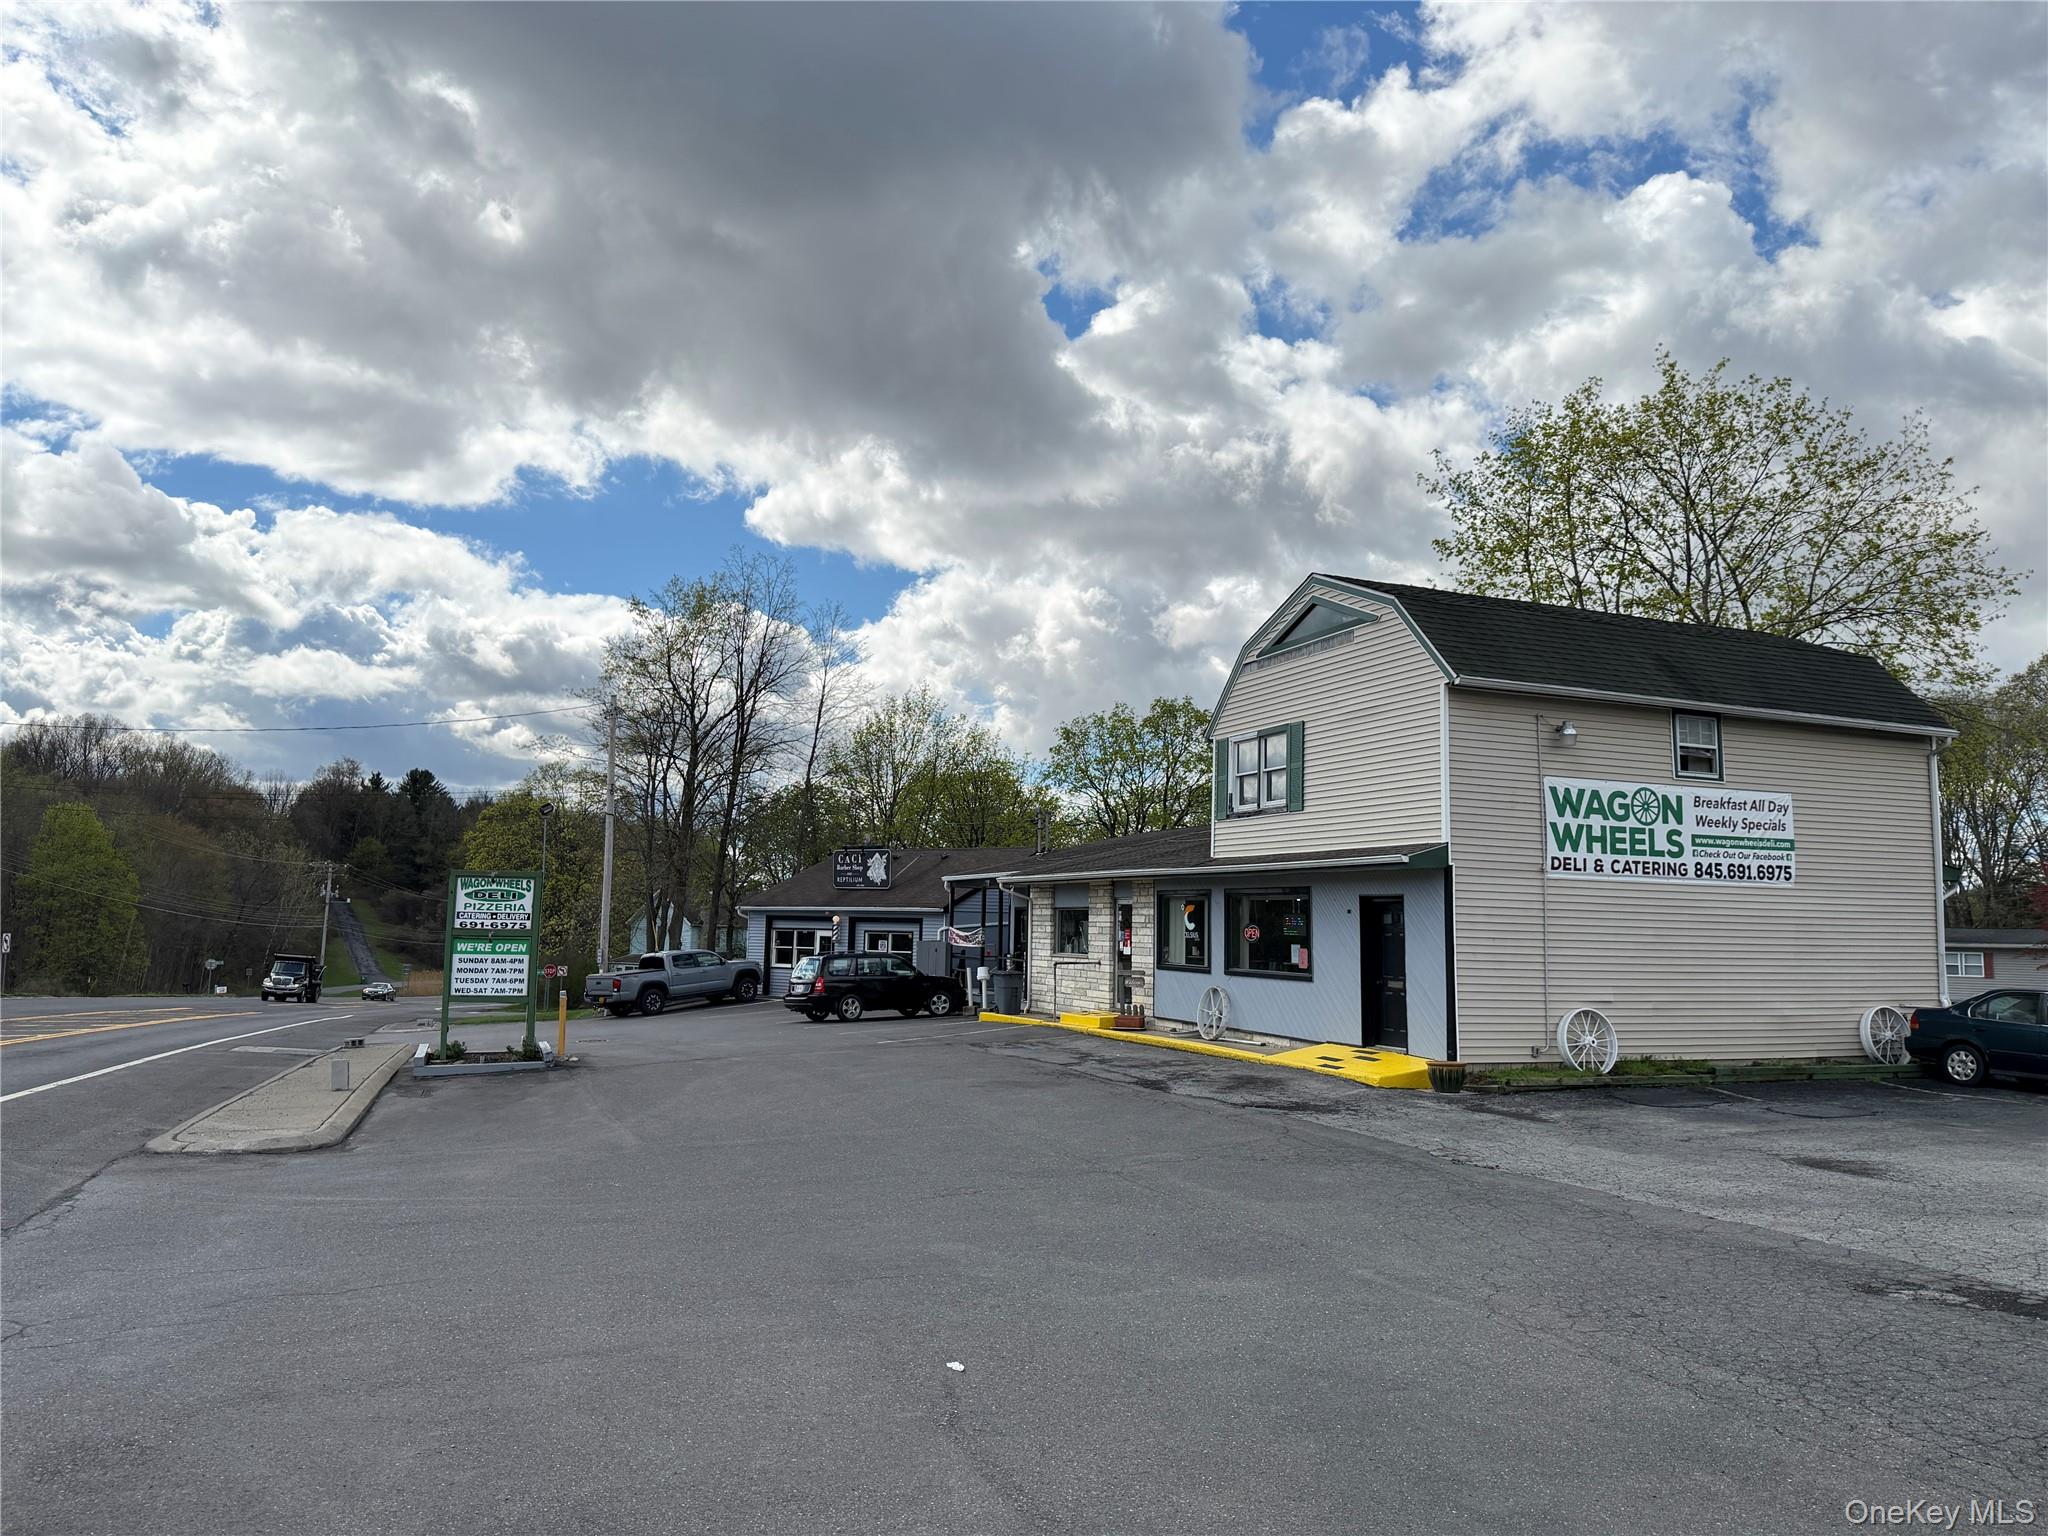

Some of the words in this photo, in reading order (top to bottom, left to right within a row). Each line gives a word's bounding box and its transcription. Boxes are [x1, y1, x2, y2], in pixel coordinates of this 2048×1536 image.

[1549, 786, 1683, 826] WAGON
[1693, 796, 1747, 811] Breakfast
[1749, 799, 1765, 812] All
[1768, 800, 1789, 816] Day
[1695, 815, 1738, 832] Weekly
[1741, 818, 1786, 833] Specials
[1549, 822, 1685, 859] WHEELS
[1694, 837, 1791, 848] www.wagonwheelsdeli.com
[1699, 849, 1721, 858] Check
[1722, 850, 1736, 859] Out
[1738, 851, 1751, 860] Our
[1752, 852, 1785, 861] Facebook
[1550, 856, 1587, 873] DELI
[1593, 858, 1604, 873] &
[1610, 859, 1688, 877] CATERING
[1694, 861, 1792, 881] 845.691.6975
[460, 878, 492, 891] WAGON
[495, 878, 532, 892] WHEELS
[473, 891, 518, 899] DELI
[463, 902, 526, 911] PIZZERIA
[459, 921, 527, 929] 691-6975
[1244, 928, 1260, 938] OPEN
[457, 942, 493, 951] WE'RE
[495, 943, 527, 952] OPEN
